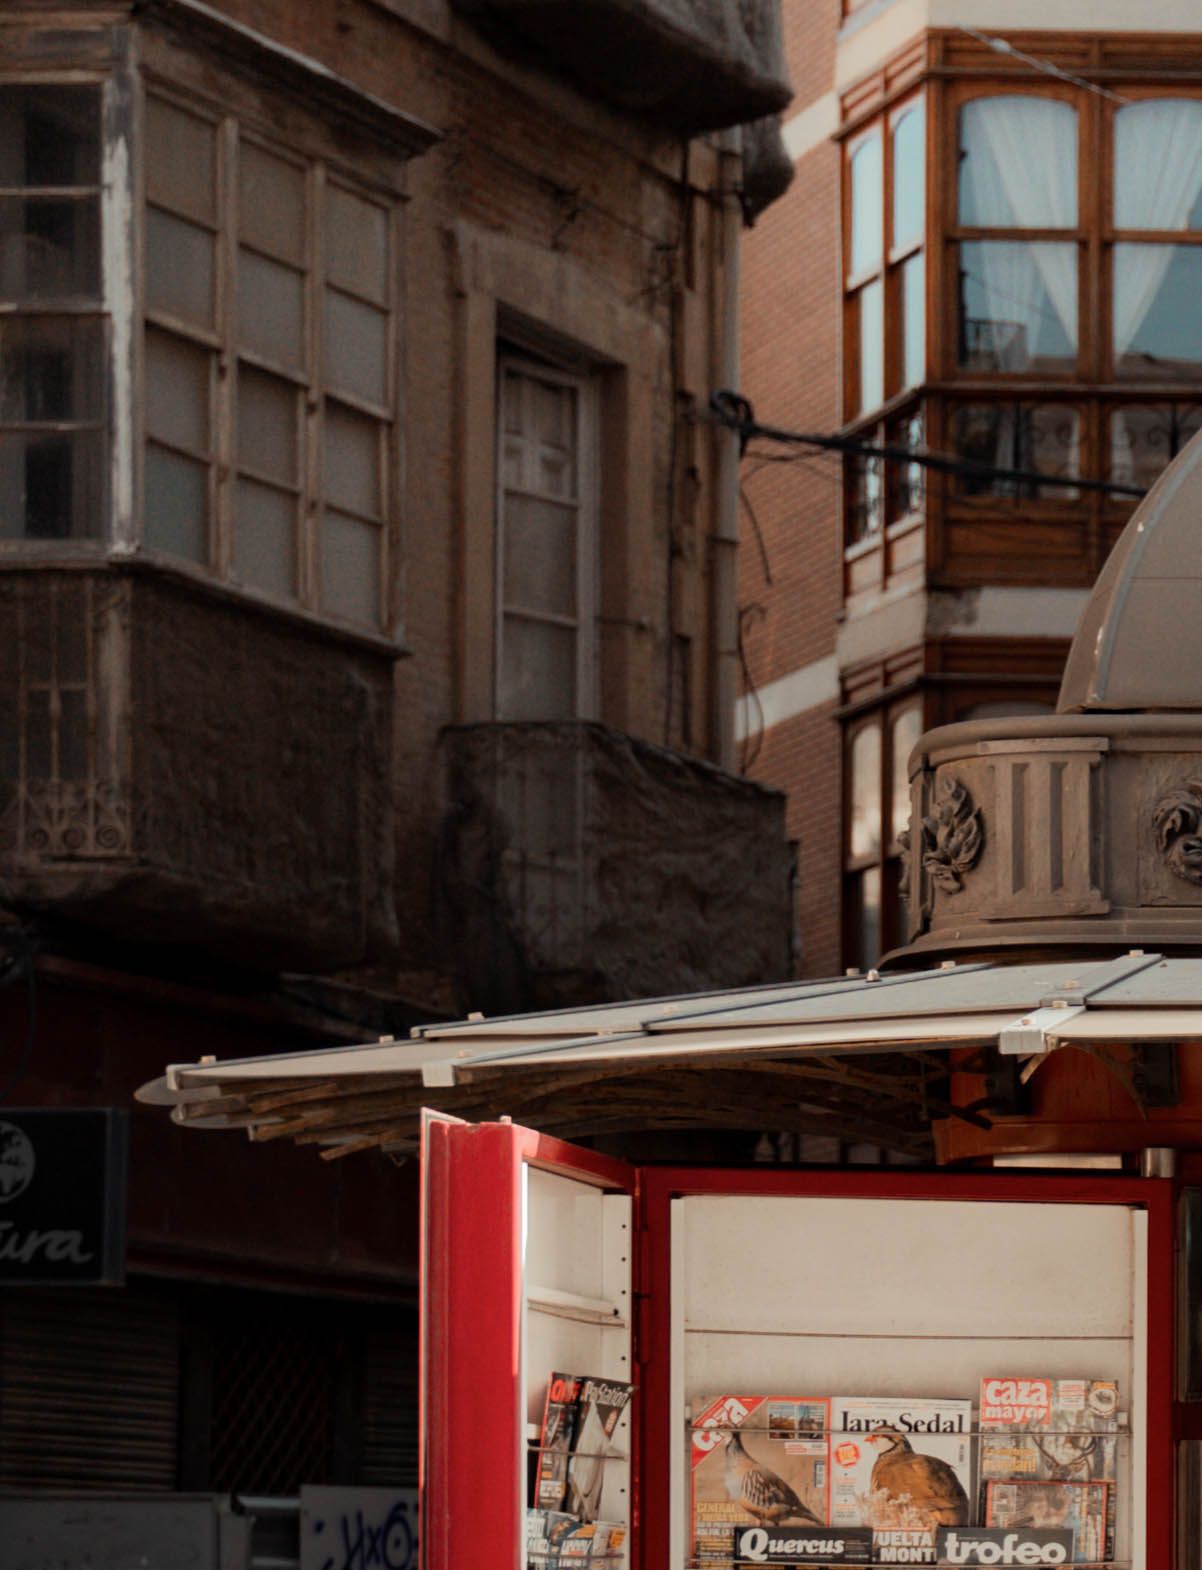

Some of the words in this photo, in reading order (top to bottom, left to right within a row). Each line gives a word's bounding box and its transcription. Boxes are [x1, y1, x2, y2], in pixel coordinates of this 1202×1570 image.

[986, 1380, 1048, 1406] caza
[899, 1413, 963, 1433] Sedal
[985, 1406, 1048, 1423] mayor
[740, 1528, 845, 1561] Quercus
[945, 1532, 1067, 1565] trofeo
